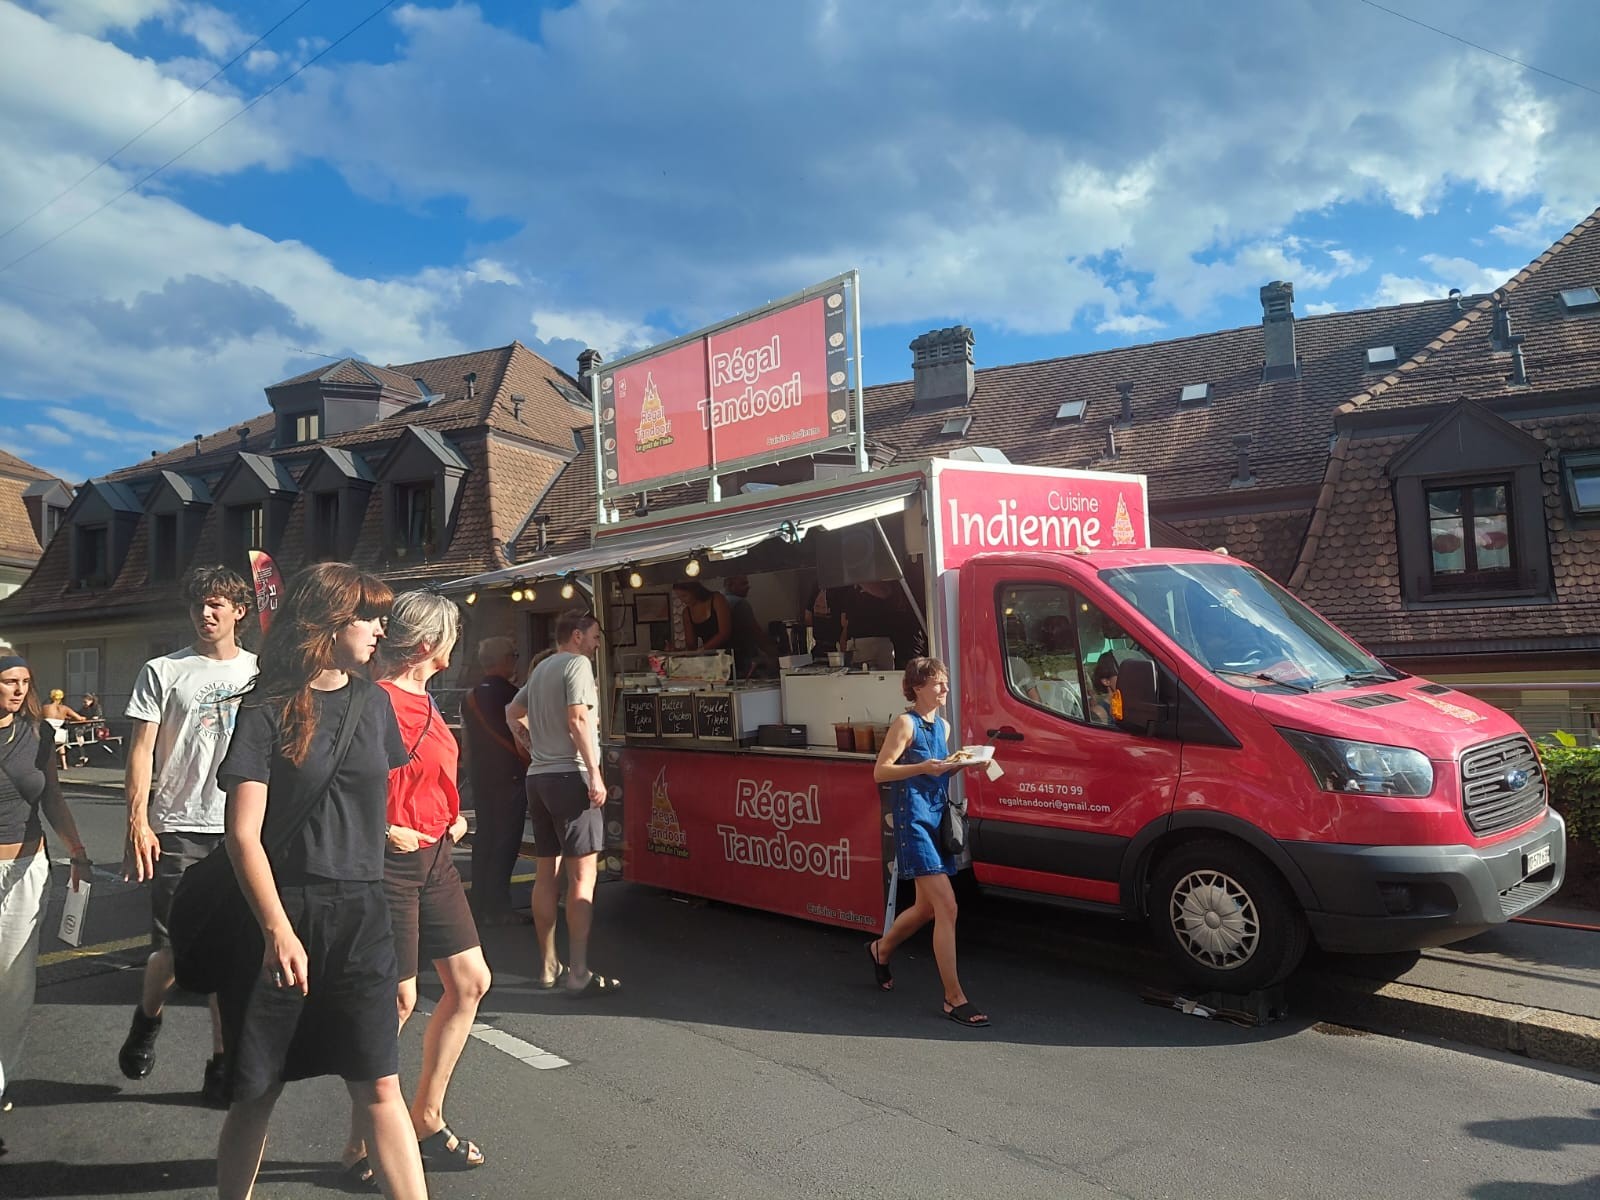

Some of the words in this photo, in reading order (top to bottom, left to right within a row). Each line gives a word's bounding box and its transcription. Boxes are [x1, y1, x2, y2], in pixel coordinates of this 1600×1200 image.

[713, 334, 781, 387] Régal
[697, 371, 802, 431] Tandoori
[635, 419, 671, 441] Tandoori
[1048, 491, 1098, 512] Cuisine
[948, 498, 1101, 547] Indienne
[195, 682, 226, 702] GAMLA
[661, 699, 684, 712] Butter
[699, 699, 729, 714] Poulet
[668, 712, 692, 722] Chicken
[706, 714, 729, 726] Tikka
[1019, 783, 1036, 792] 076
[1038, 783, 1054, 793] 415
[1056, 785, 1068, 794] 70
[1071, 786, 1083, 795] 99
[736, 778, 821, 830] Régal
[999, 797, 1111, 812] regaltandoori@gmail.com
[646, 823, 687, 845] Tandoori
[717, 824, 850, 880] Tandoori
[806, 902, 837, 918] Cuisine
